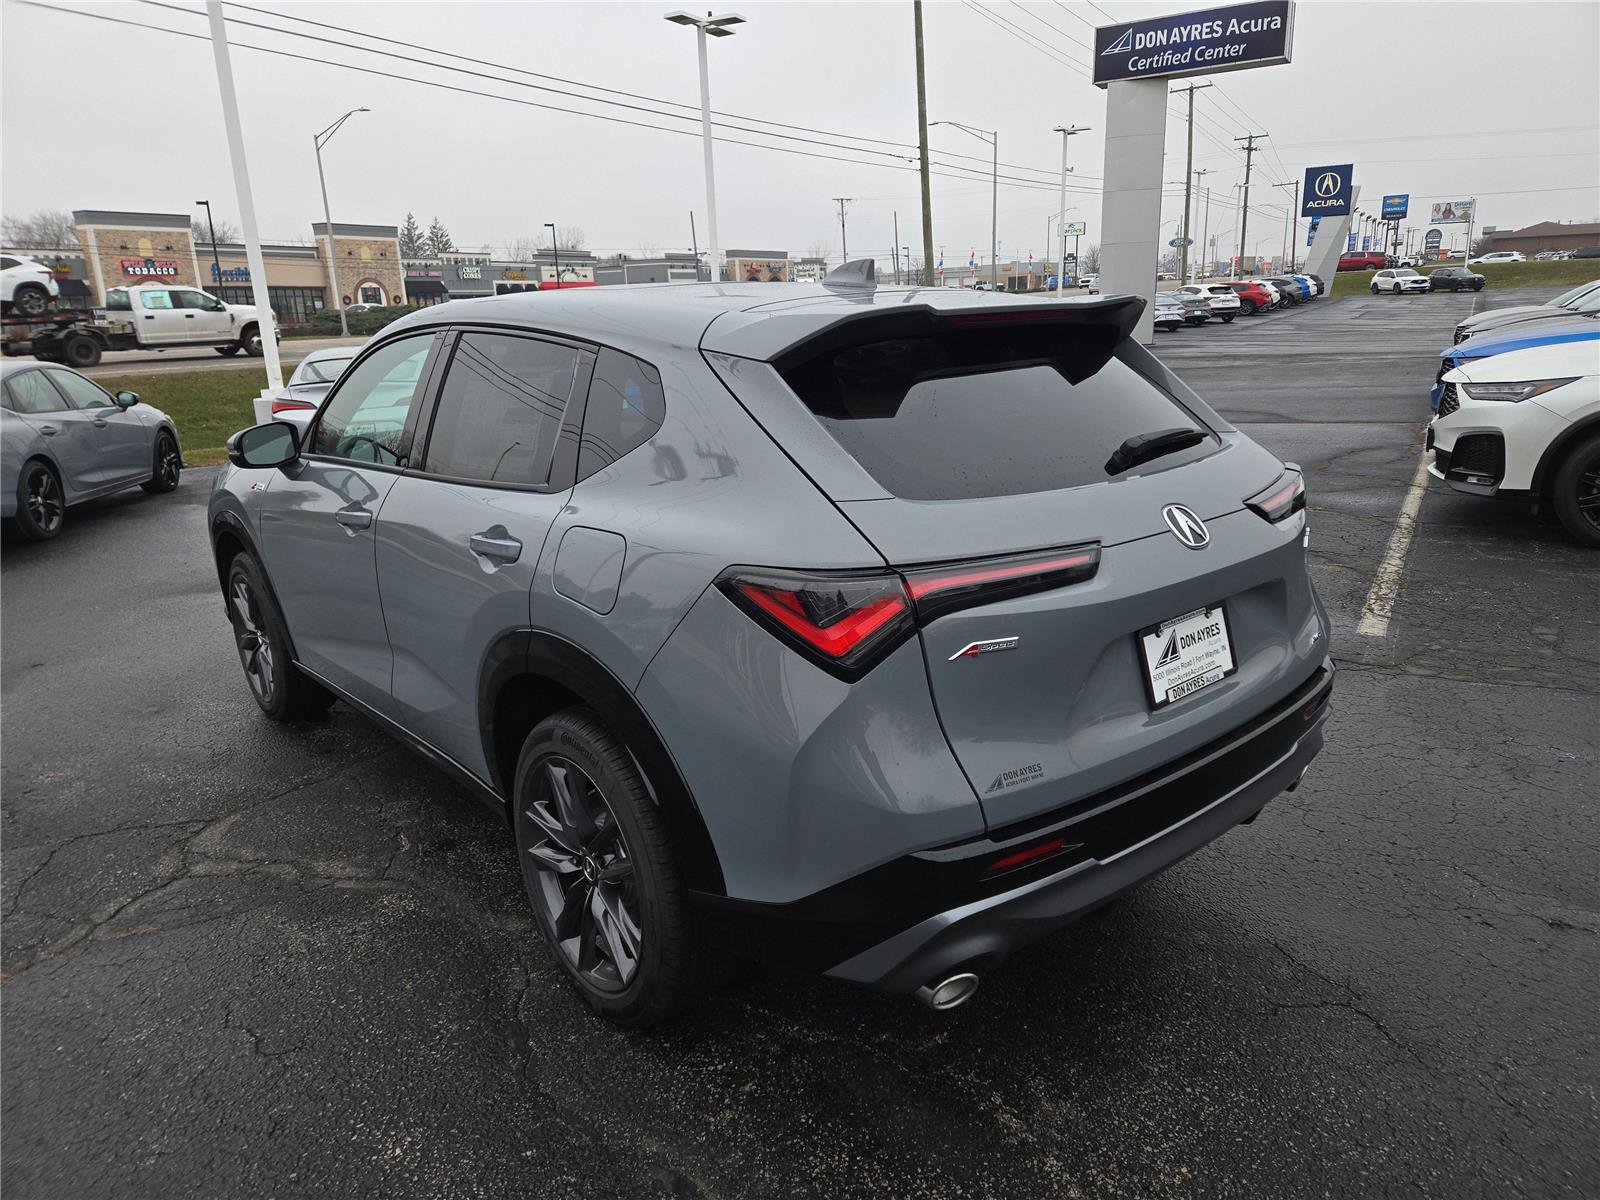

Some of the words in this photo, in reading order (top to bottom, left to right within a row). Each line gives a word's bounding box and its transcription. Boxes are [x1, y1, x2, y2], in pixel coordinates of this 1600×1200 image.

[1135, 28, 1167, 50] DON
[1169, 20, 1223, 45] AYRES
[1226, 15, 1281, 36] Acura
[1128, 47, 1190, 71] Certified
[1195, 42, 1247, 62] Center
[1306, 199, 1345, 208] ACURA
[127, 267, 175, 275] TOBACCO
[1180, 632, 1196, 650] DON
[1196, 622, 1221, 644] AYRES
[1172, 685, 1187, 699] DON
[1186, 675, 1206, 693] AYRES
[1002, 769, 1019, 781] DON
[1019, 763, 1043, 776] AYRES
